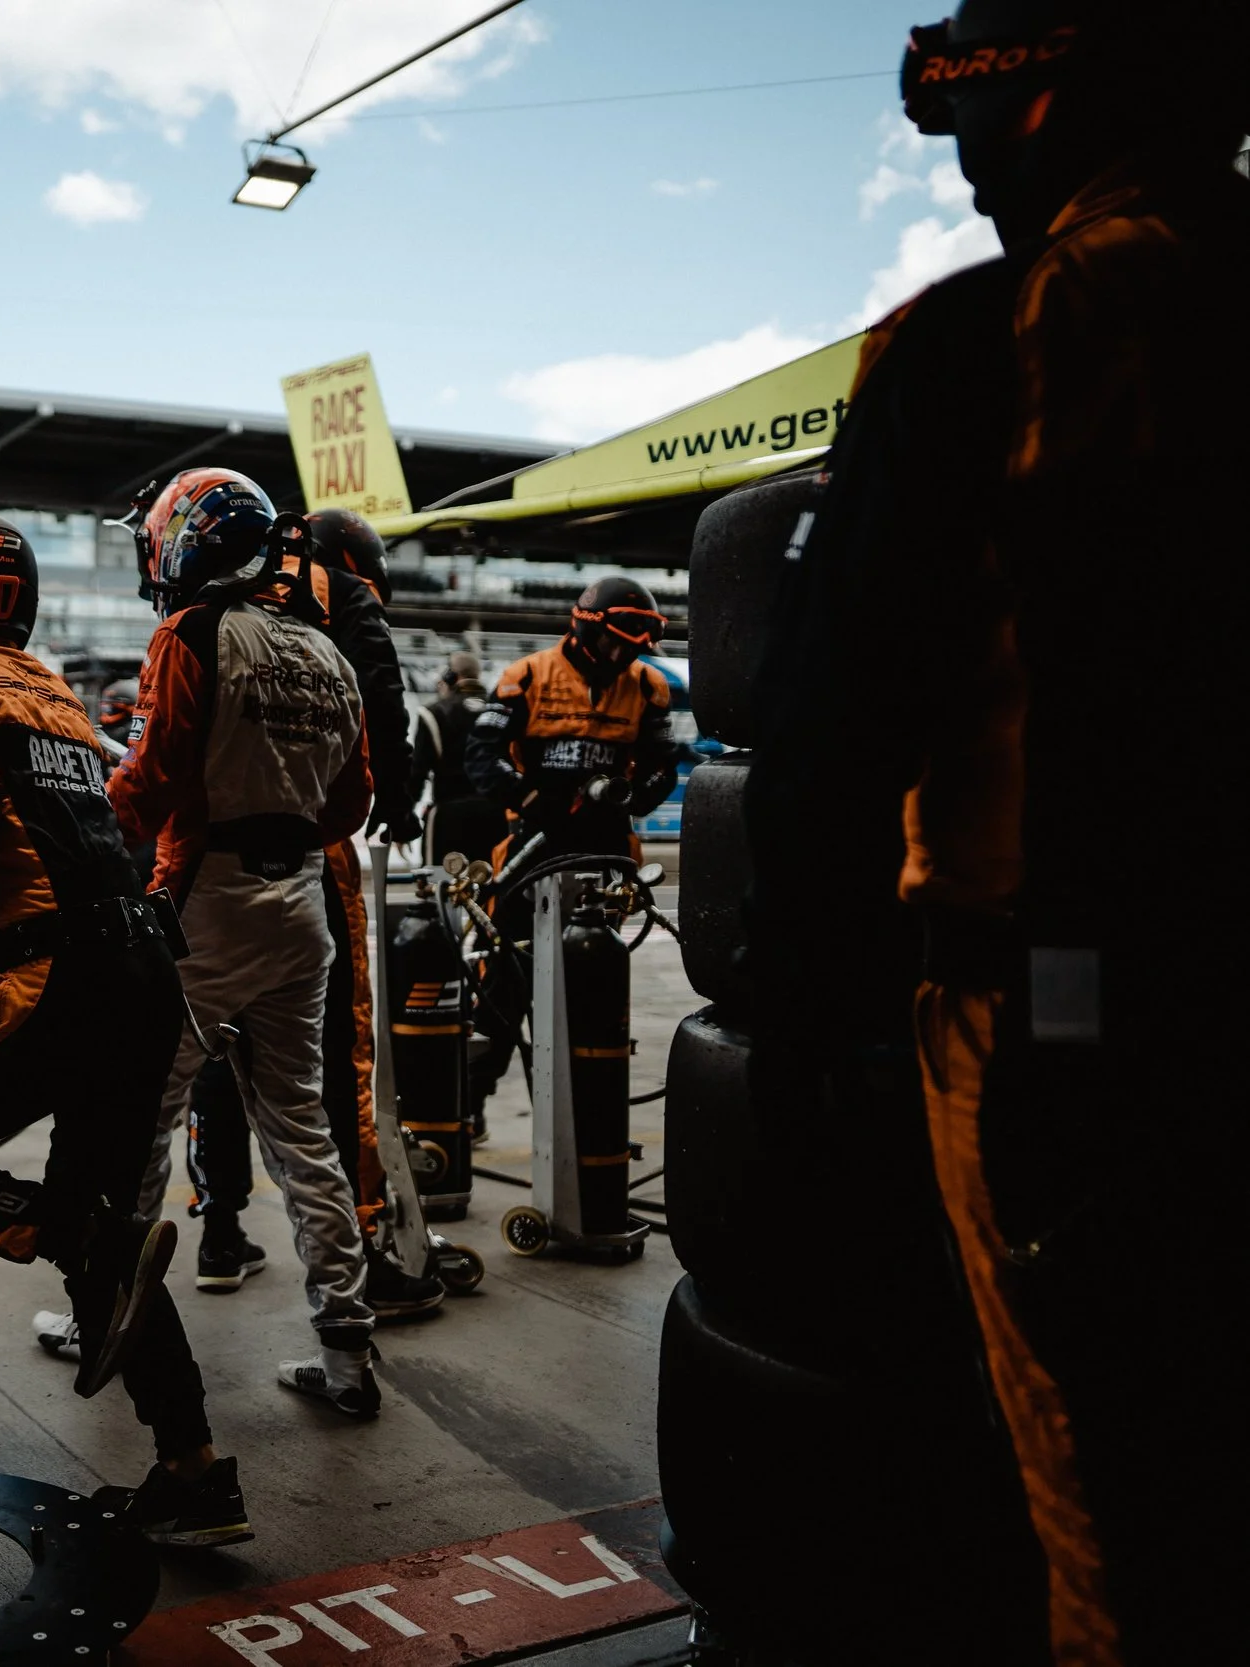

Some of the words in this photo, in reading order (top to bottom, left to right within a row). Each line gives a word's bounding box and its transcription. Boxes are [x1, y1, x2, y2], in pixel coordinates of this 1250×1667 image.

[312, 384, 366, 443] RACE
[647, 398, 847, 463] www.get
[312, 440, 366, 499] TAXI
